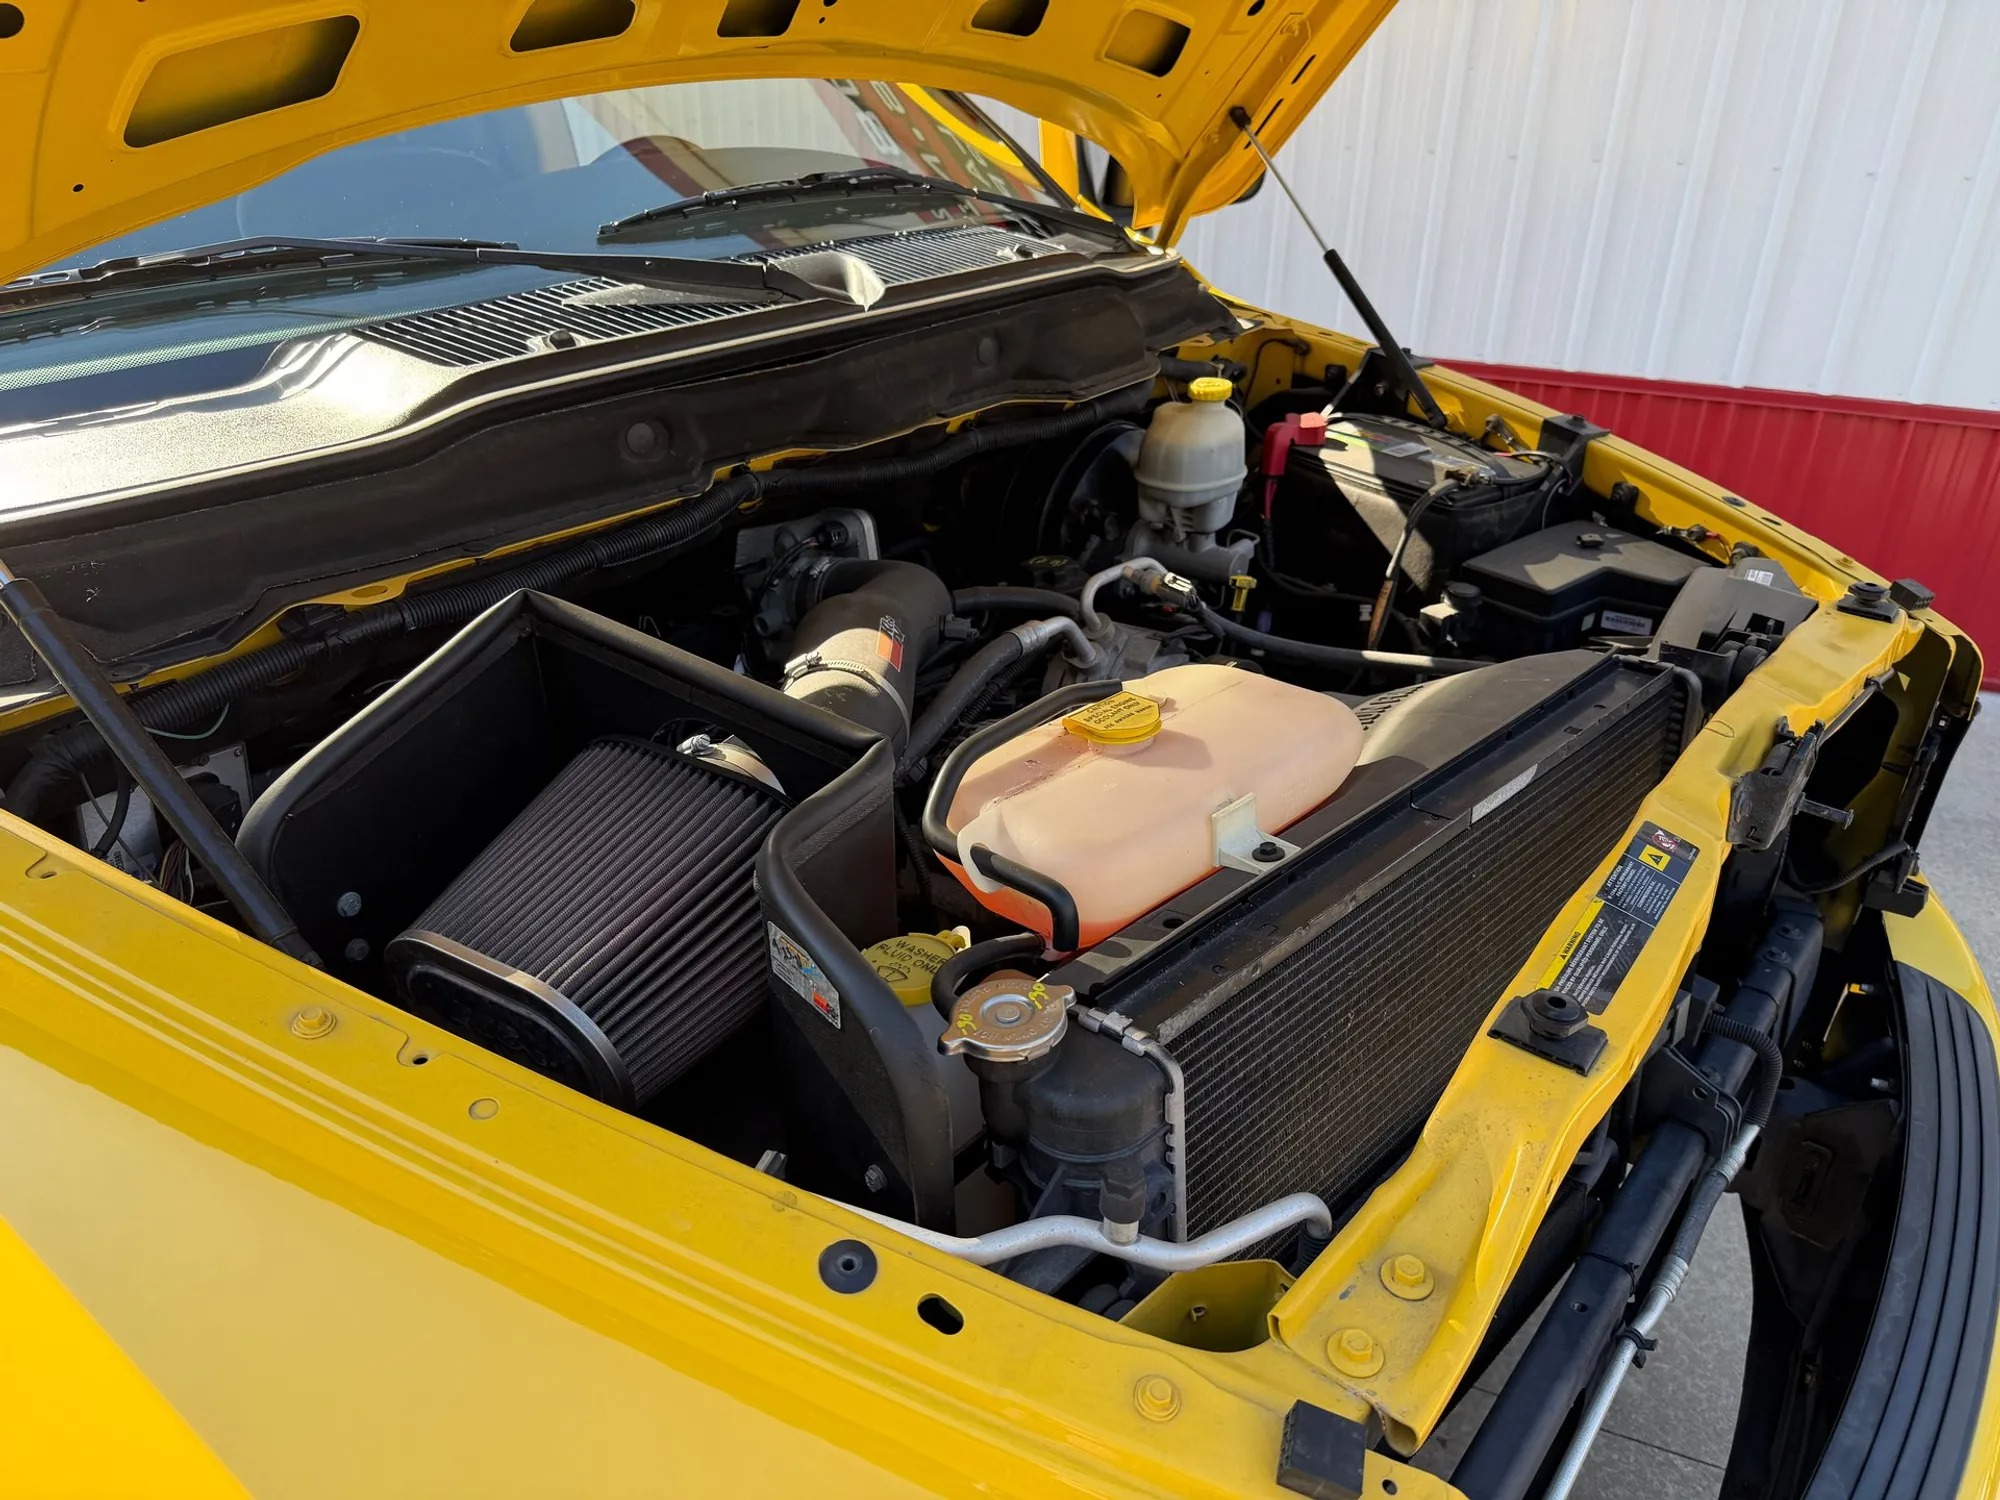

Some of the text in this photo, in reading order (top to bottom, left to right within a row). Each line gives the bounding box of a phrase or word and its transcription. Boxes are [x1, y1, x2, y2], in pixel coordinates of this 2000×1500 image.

[1083, 708, 1112, 722] SPECIAL
[1094, 708, 1124, 724] COOLANT
[1607, 865, 1623, 887] ATTENTION
[1616, 881, 1628, 897] FACTORY
[896, 940, 947, 964] WASHER
[1564, 931, 1581, 954] WARNING
[876, 943, 938, 973] FLUID ONL
[1562, 981, 1573, 995] VICED
[1586, 936, 1602, 958] PERSONNEL
[1570, 943, 1588, 968] REFRIGERANT
